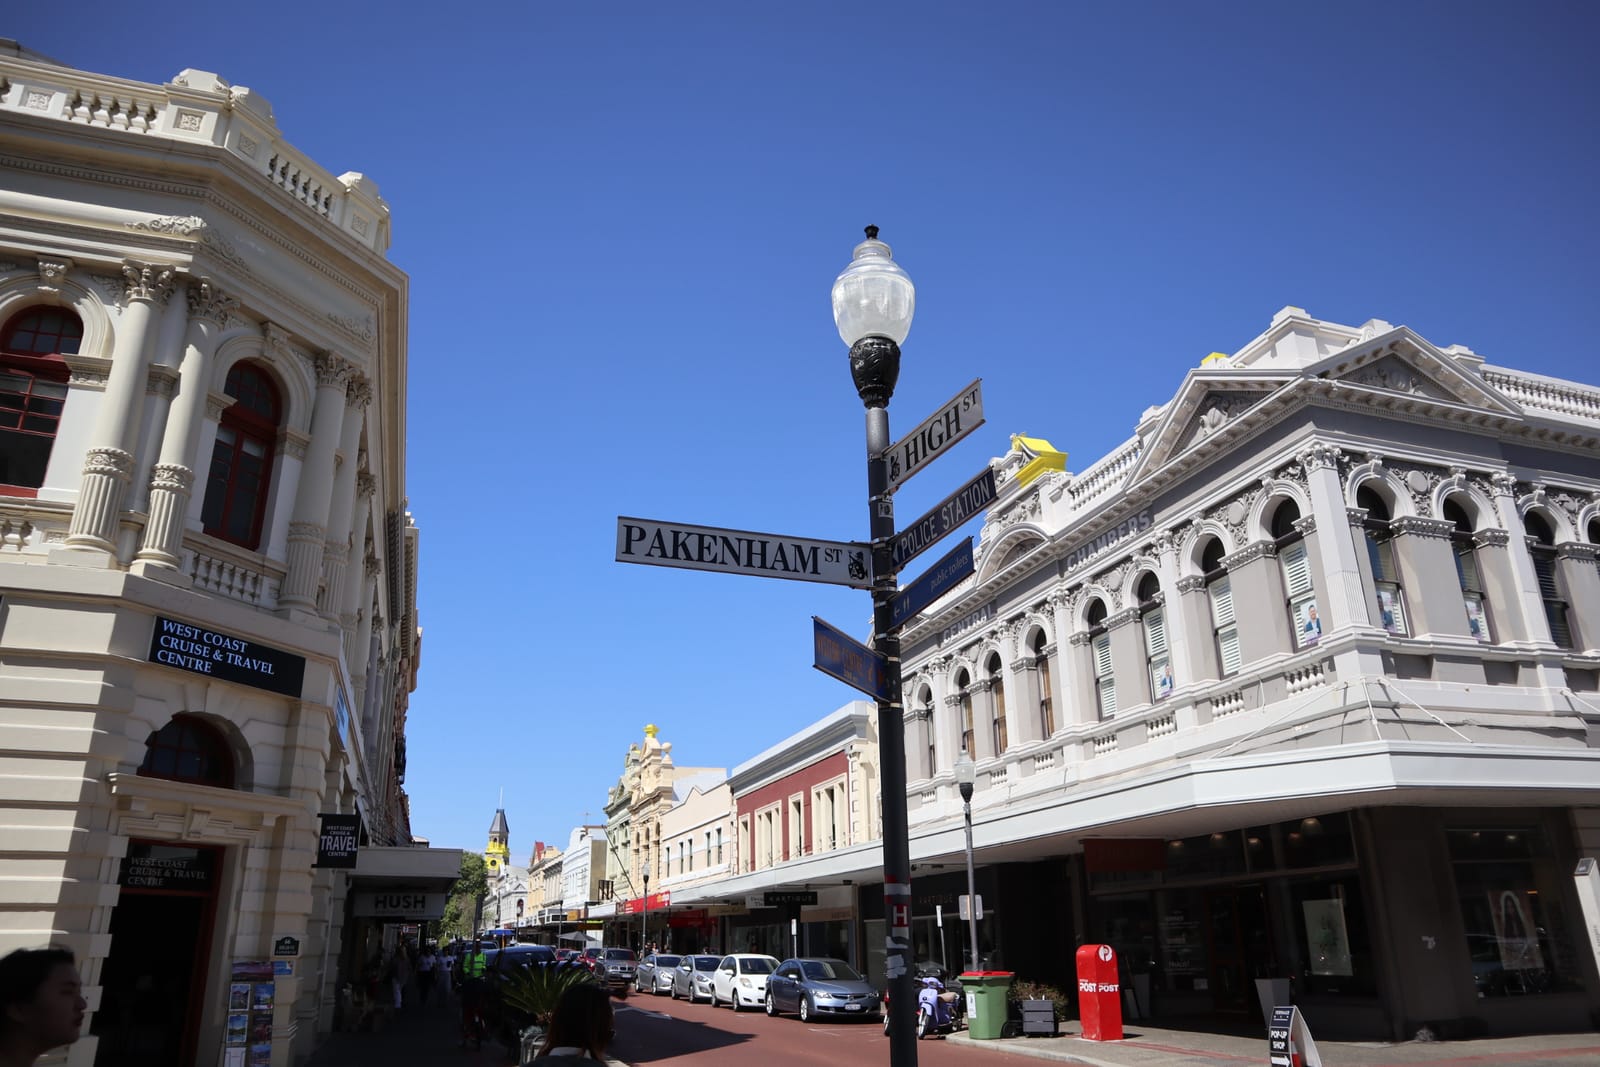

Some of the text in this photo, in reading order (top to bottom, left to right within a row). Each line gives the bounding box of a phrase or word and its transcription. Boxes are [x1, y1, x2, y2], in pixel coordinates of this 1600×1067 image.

[904, 388, 978, 472] HIGH ST
[901, 475, 991, 560] POLICE STATION
[621, 524, 843, 575] PAKENHAM ST
[1066, 510, 1151, 572] CHAMBERS
[930, 553, 969, 593] public toilets
[162, 619, 249, 653] WEST COAST
[943, 604, 994, 645] CENTRAL
[157, 649, 212, 673] CENTRE
[160, 635, 275, 675] CRUISE & TRAVEL
[320, 835, 358, 851] TRAVEL
[129, 866, 162, 877] CRUISE
[174, 869, 207, 880] TRAVEL
[131, 857, 188, 869] WEST COAST
[127, 876, 165, 887] CENTRE
[374, 895, 426, 909] HUSH
[1079, 982, 1097, 992] POST
[1098, 984, 1119, 993] POST
[1270, 1030, 1288, 1039] POP-UP
